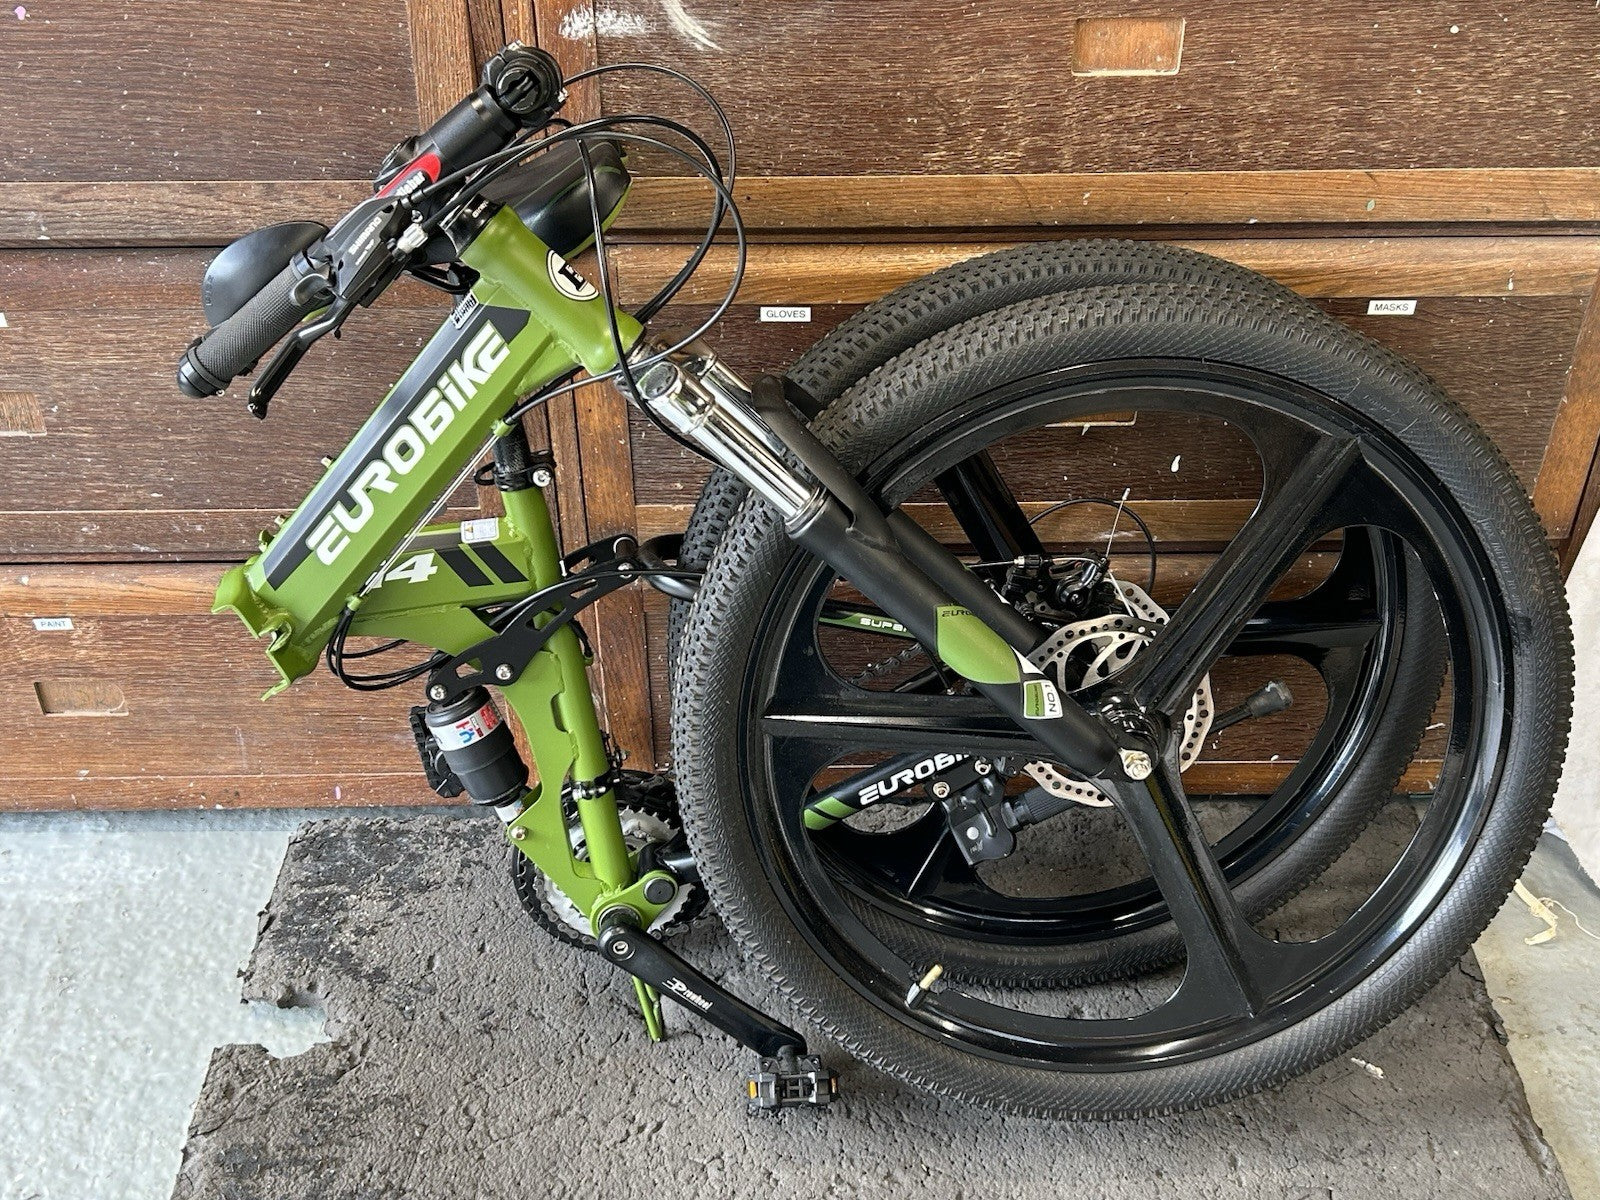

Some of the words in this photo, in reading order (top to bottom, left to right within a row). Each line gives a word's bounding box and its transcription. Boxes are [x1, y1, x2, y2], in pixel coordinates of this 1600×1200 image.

[348, 216, 382, 255] SHIMANO
[766, 310, 806, 318] GLOVES
[1374, 303, 1409, 311] MASKS
[858, 752, 970, 806] EUROB
